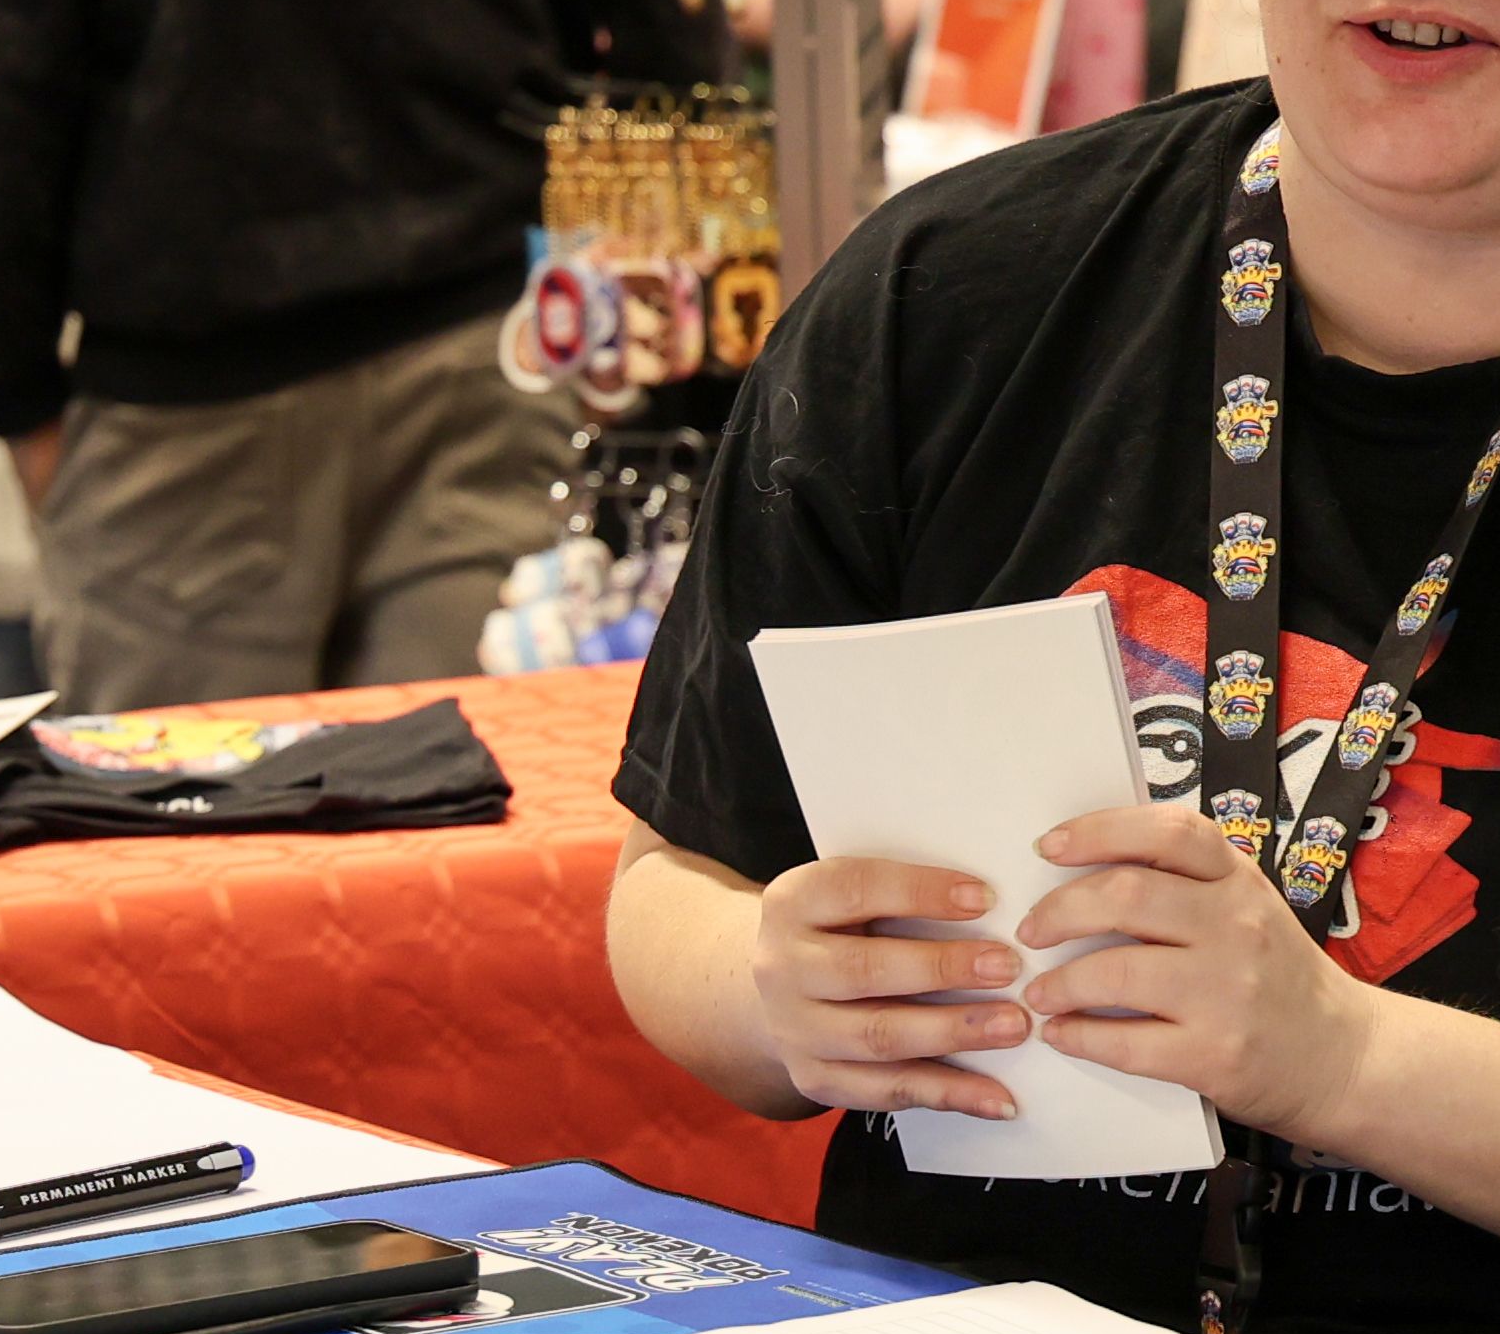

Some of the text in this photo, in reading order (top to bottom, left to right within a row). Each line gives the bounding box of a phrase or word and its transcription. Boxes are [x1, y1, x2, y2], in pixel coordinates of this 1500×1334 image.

[20, 1177, 116, 1206] PERMANENT
[122, 1163, 188, 1186] MARKER
[477, 1226, 744, 1292] PLAY!
